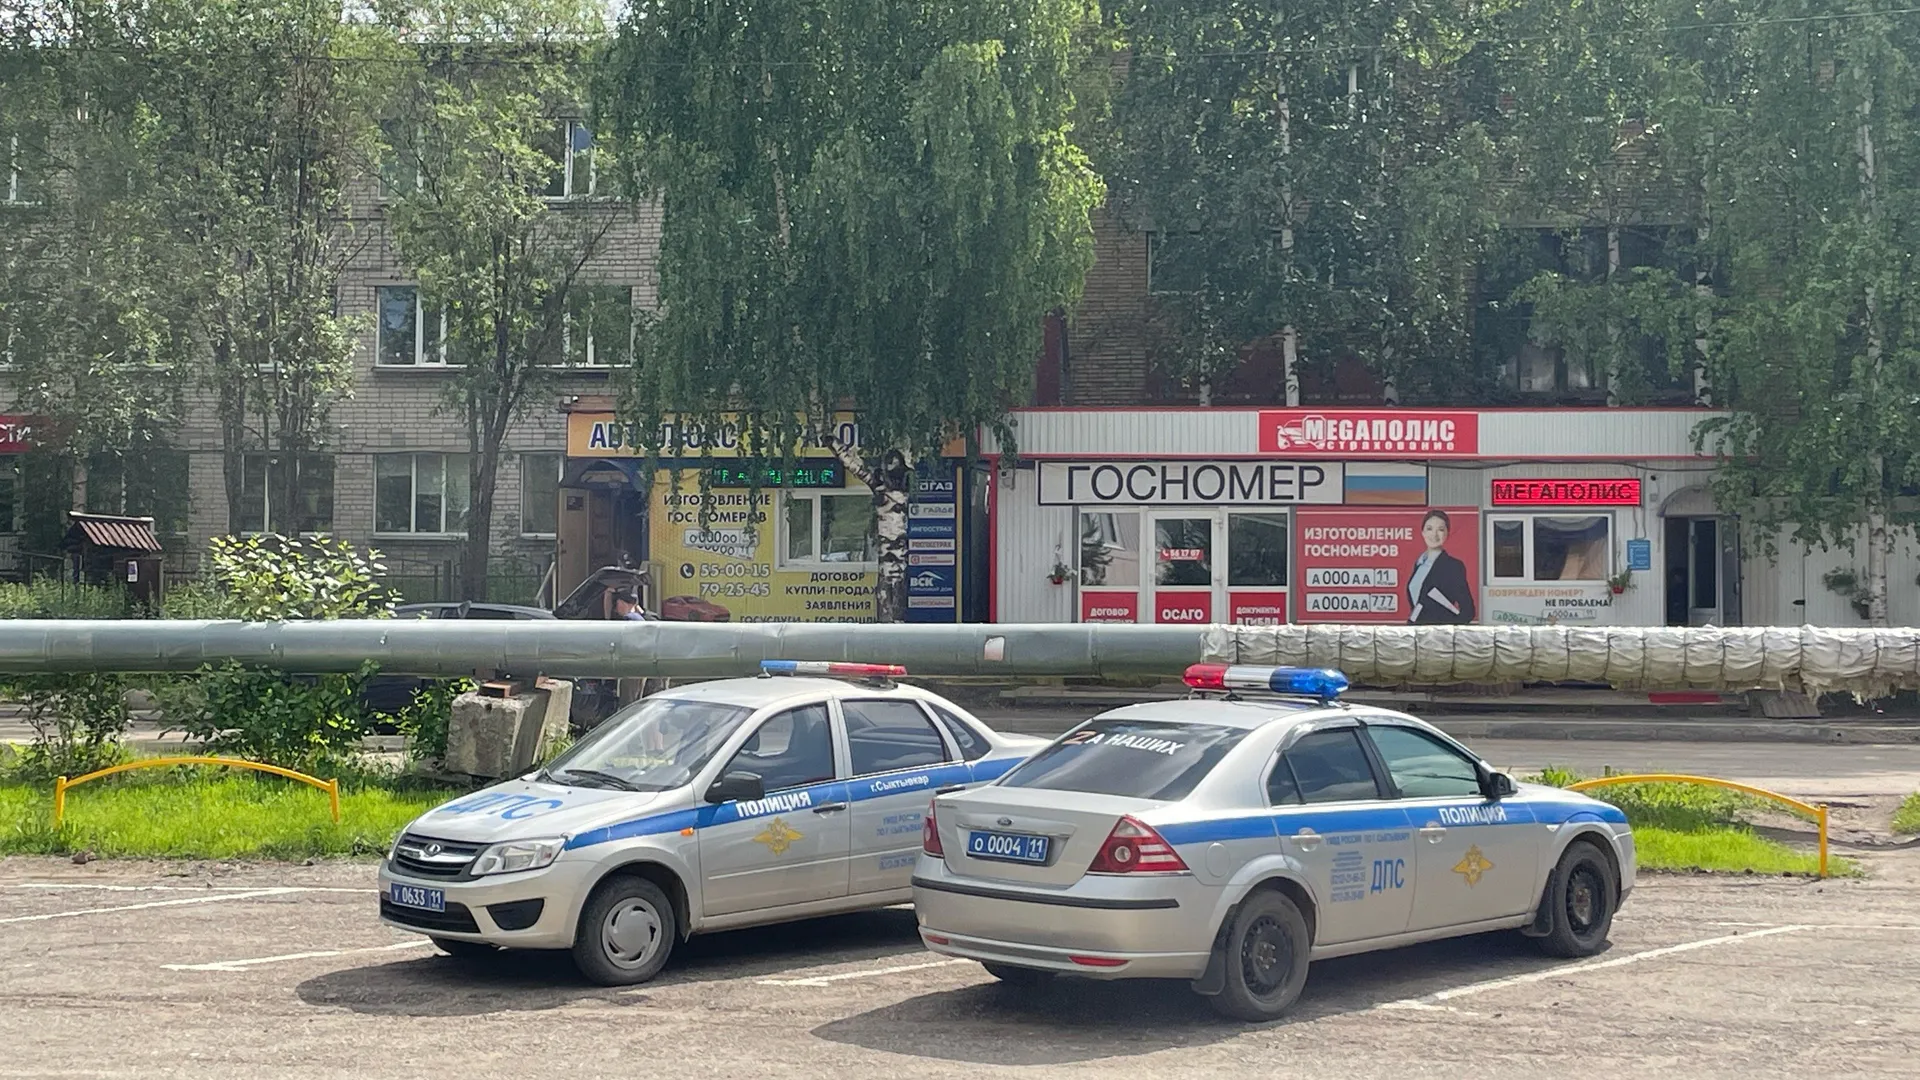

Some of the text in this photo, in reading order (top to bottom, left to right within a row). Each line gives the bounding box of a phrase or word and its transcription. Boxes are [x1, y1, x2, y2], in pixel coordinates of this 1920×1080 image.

[1067, 464, 1326, 501] ГОСНОМЕР
[1494, 483, 1633, 500] МЕГАПОЛИС
[664, 494, 771, 506] ИЗГООВЛЕНИЕ
[699, 511, 767, 523] ОМЕРВ
[1304, 527, 1413, 540] ИЗГОТОВЛЕНИЕ
[1304, 543, 1399, 557] ГОСНОМЕРОВ
[700, 562, 771, 578] 55-00-15
[1376, 569, 1389, 581] 11
[810, 572, 866, 583] ДОГОВОР
[910, 576, 934, 587] ВСК
[700, 582, 771, 598] 79-25-45
[1488, 588, 1584, 598] ПОВРЕЖДЕН НОМЕР?
[805, 600, 871, 610] ЗАЯВЛЕНИЯ
[1371, 594, 1394, 607] 777
[1545, 599, 1557, 607] НЕ
[1089, 607, 1130, 617] ДОГОВОР
[1161, 607, 1204, 621] ОСАГО
[1104, 733, 1186, 756] НАШИХ
[435, 792, 564, 820] ДПС
[735, 790, 813, 819] ПОЛИЦИЯ
[1438, 805, 1507, 825] ПОЛИЦИЯ
[987, 834, 1022, 856] 0004
[1028, 838, 1044, 853] 11
[1370, 858, 1405, 895] ДПС
[401, 886, 425, 906] 0633
[430, 890, 441, 904] 11
